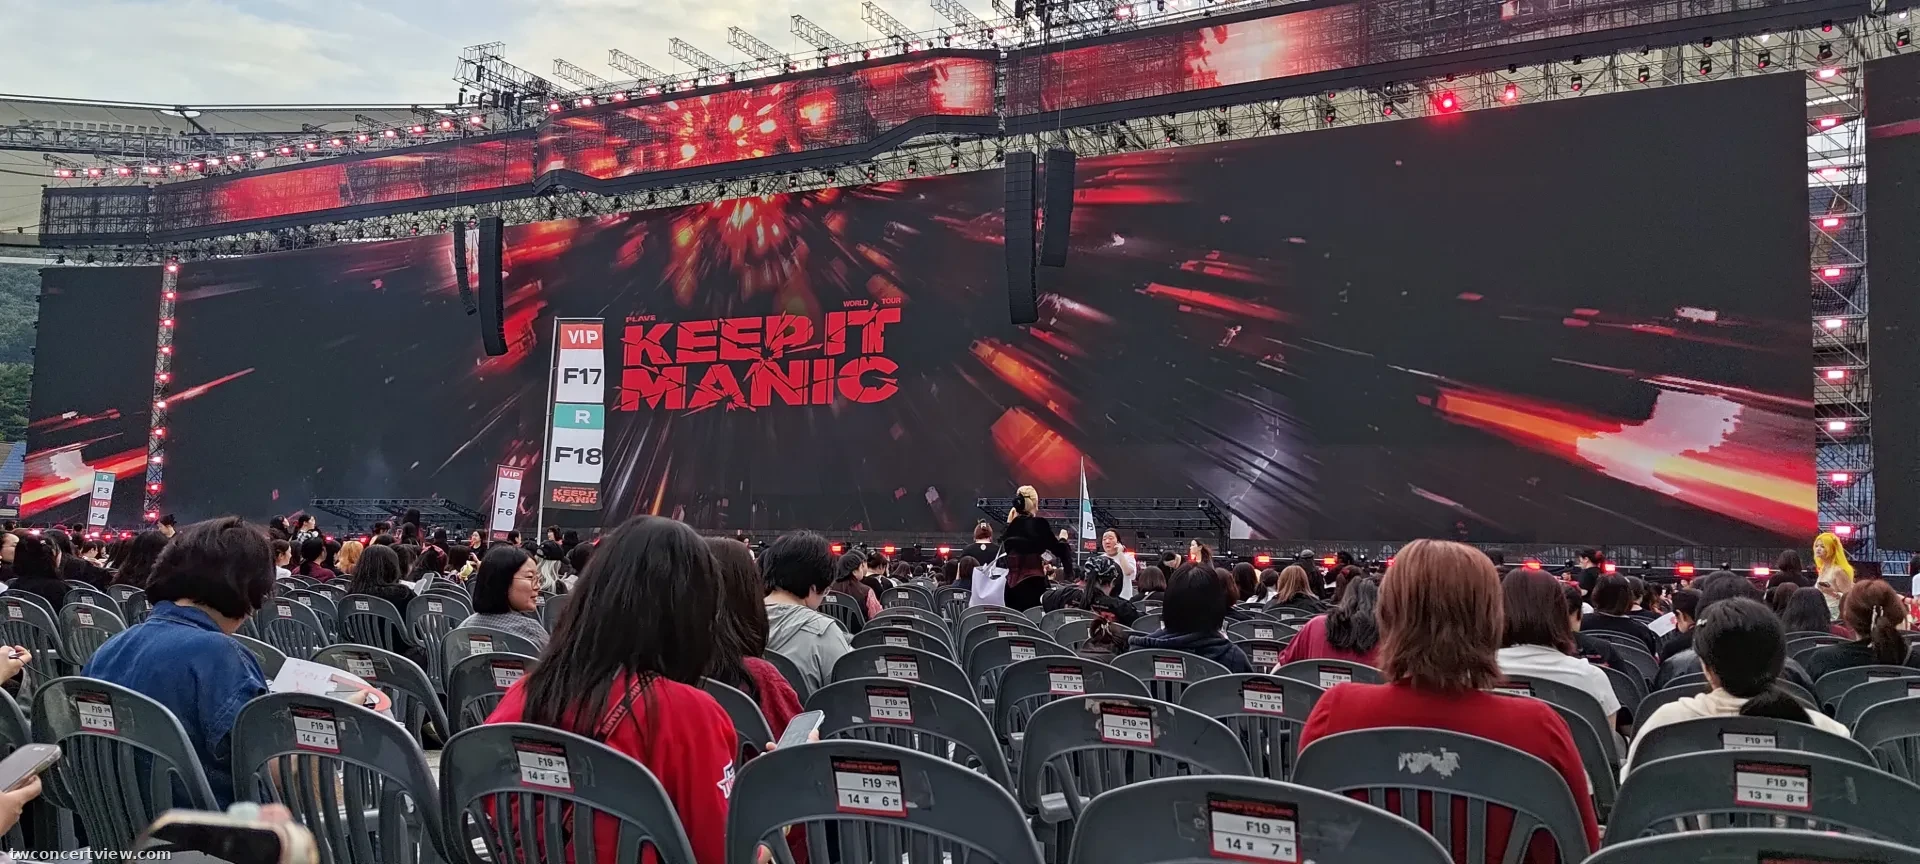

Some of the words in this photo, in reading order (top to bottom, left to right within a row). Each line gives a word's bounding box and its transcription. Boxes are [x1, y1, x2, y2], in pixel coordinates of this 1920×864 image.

[843, 299, 868, 307] WORLD
[882, 297, 902, 305] TOUR
[625, 314, 657, 323] PLAVE
[568, 330, 599, 344] VIP
[621, 312, 816, 367] KEEP
[824, 306, 902, 357] IT
[563, 368, 602, 385] F17
[619, 355, 900, 412] MANIC
[575, 410, 591, 424] R
[554, 446, 602, 465] F18
[502, 470, 520, 478] VIP
[499, 491, 516, 499] F5
[553, 488, 586, 498] KEEP
[552, 495, 598, 504] MANIC
[91, 512, 105, 520] F4
[497, 508, 513, 516] F6
[311, 722, 323, 730] F19
[303, 734, 310, 742] 14
[324, 737, 329, 745] 4
[538, 757, 553, 766] F19
[528, 771, 537, 780] 14
[554, 774, 559, 783] 5
[1766, 777, 1787, 787] F19
[862, 778, 881, 788] F19
[848, 794, 860, 803] 14
[882, 797, 889, 806] 6
[1748, 791, 1761, 799] 13
[1787, 794, 1794, 802] 8
[1246, 821, 1270, 834] F19
[1275, 826, 1291, 834] 구역
[1226, 838, 1241, 849] 14
[1272, 843, 1279, 855] 7
